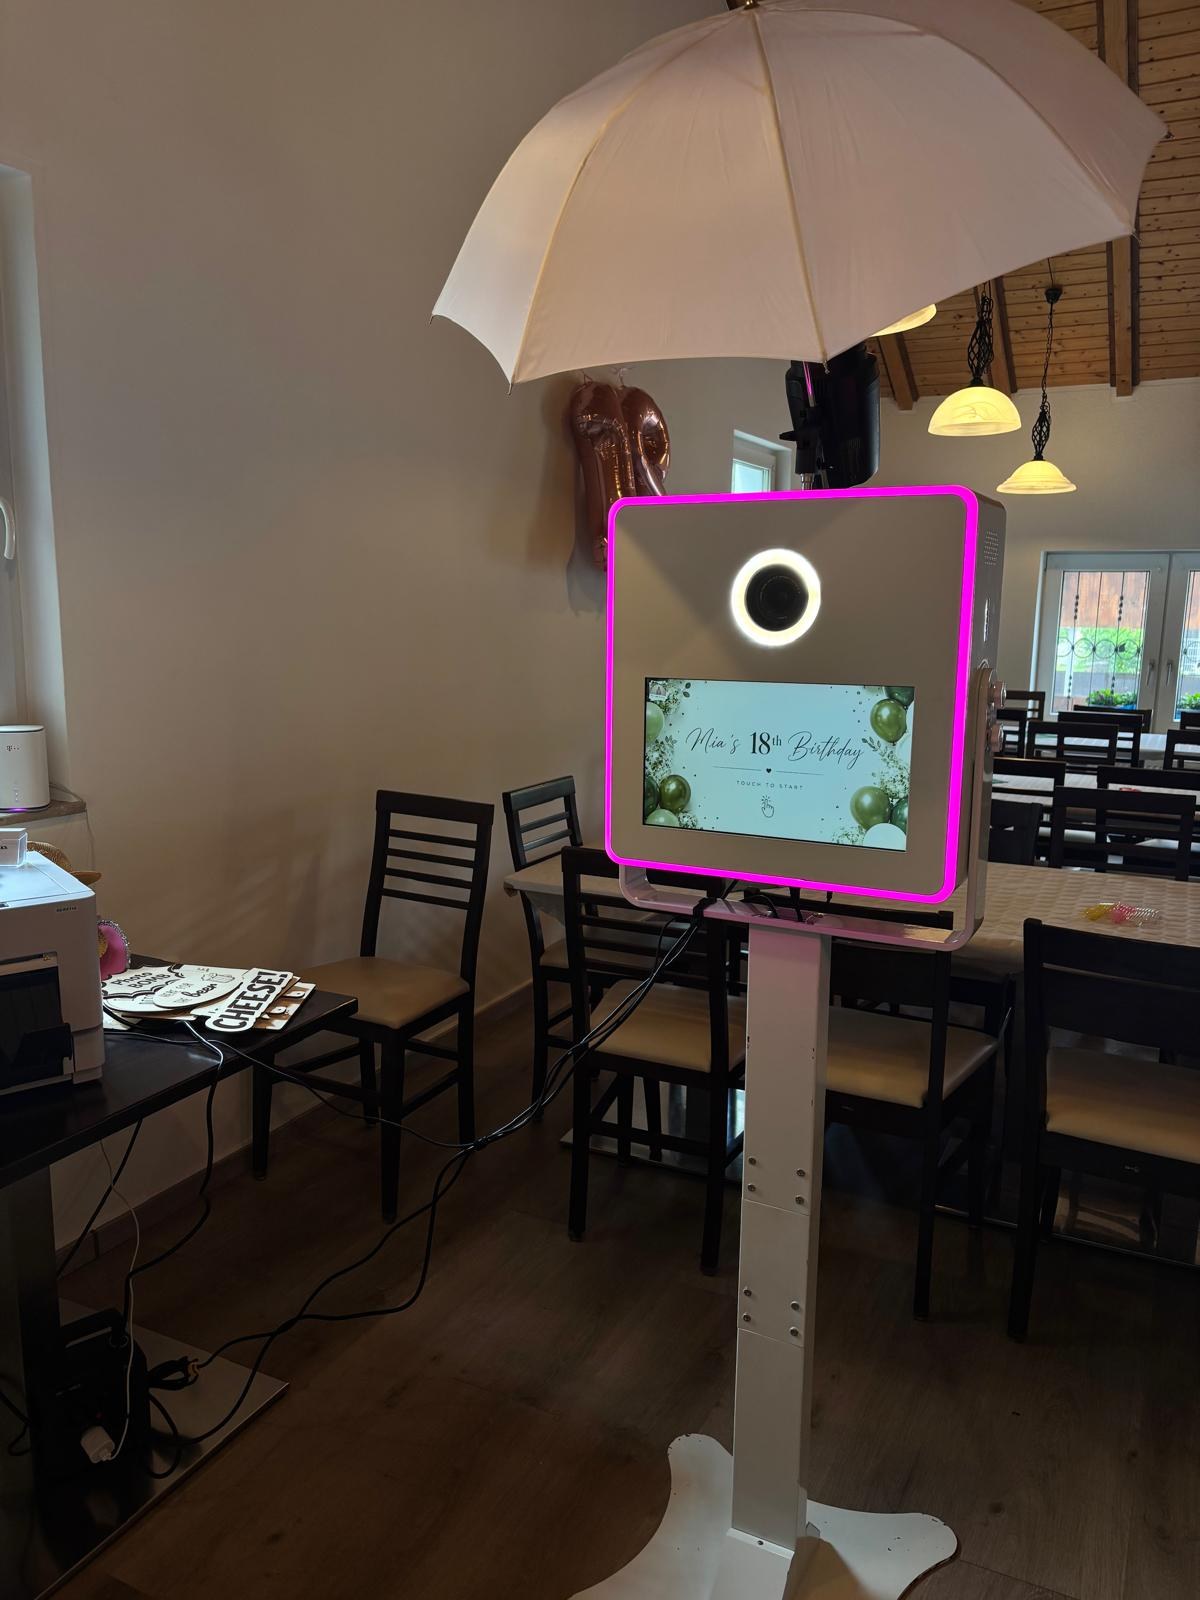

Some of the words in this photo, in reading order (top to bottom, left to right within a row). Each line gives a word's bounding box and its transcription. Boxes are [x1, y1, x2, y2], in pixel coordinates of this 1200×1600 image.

[685, 727, 740, 755] Mia's
[749, 731, 782, 756] 18th
[787, 730, 865, 770] Birthday
[779, 783, 804, 791] START
[127, 973, 171, 989] BOMB
[212, 971, 288, 1030] CHEESE!
